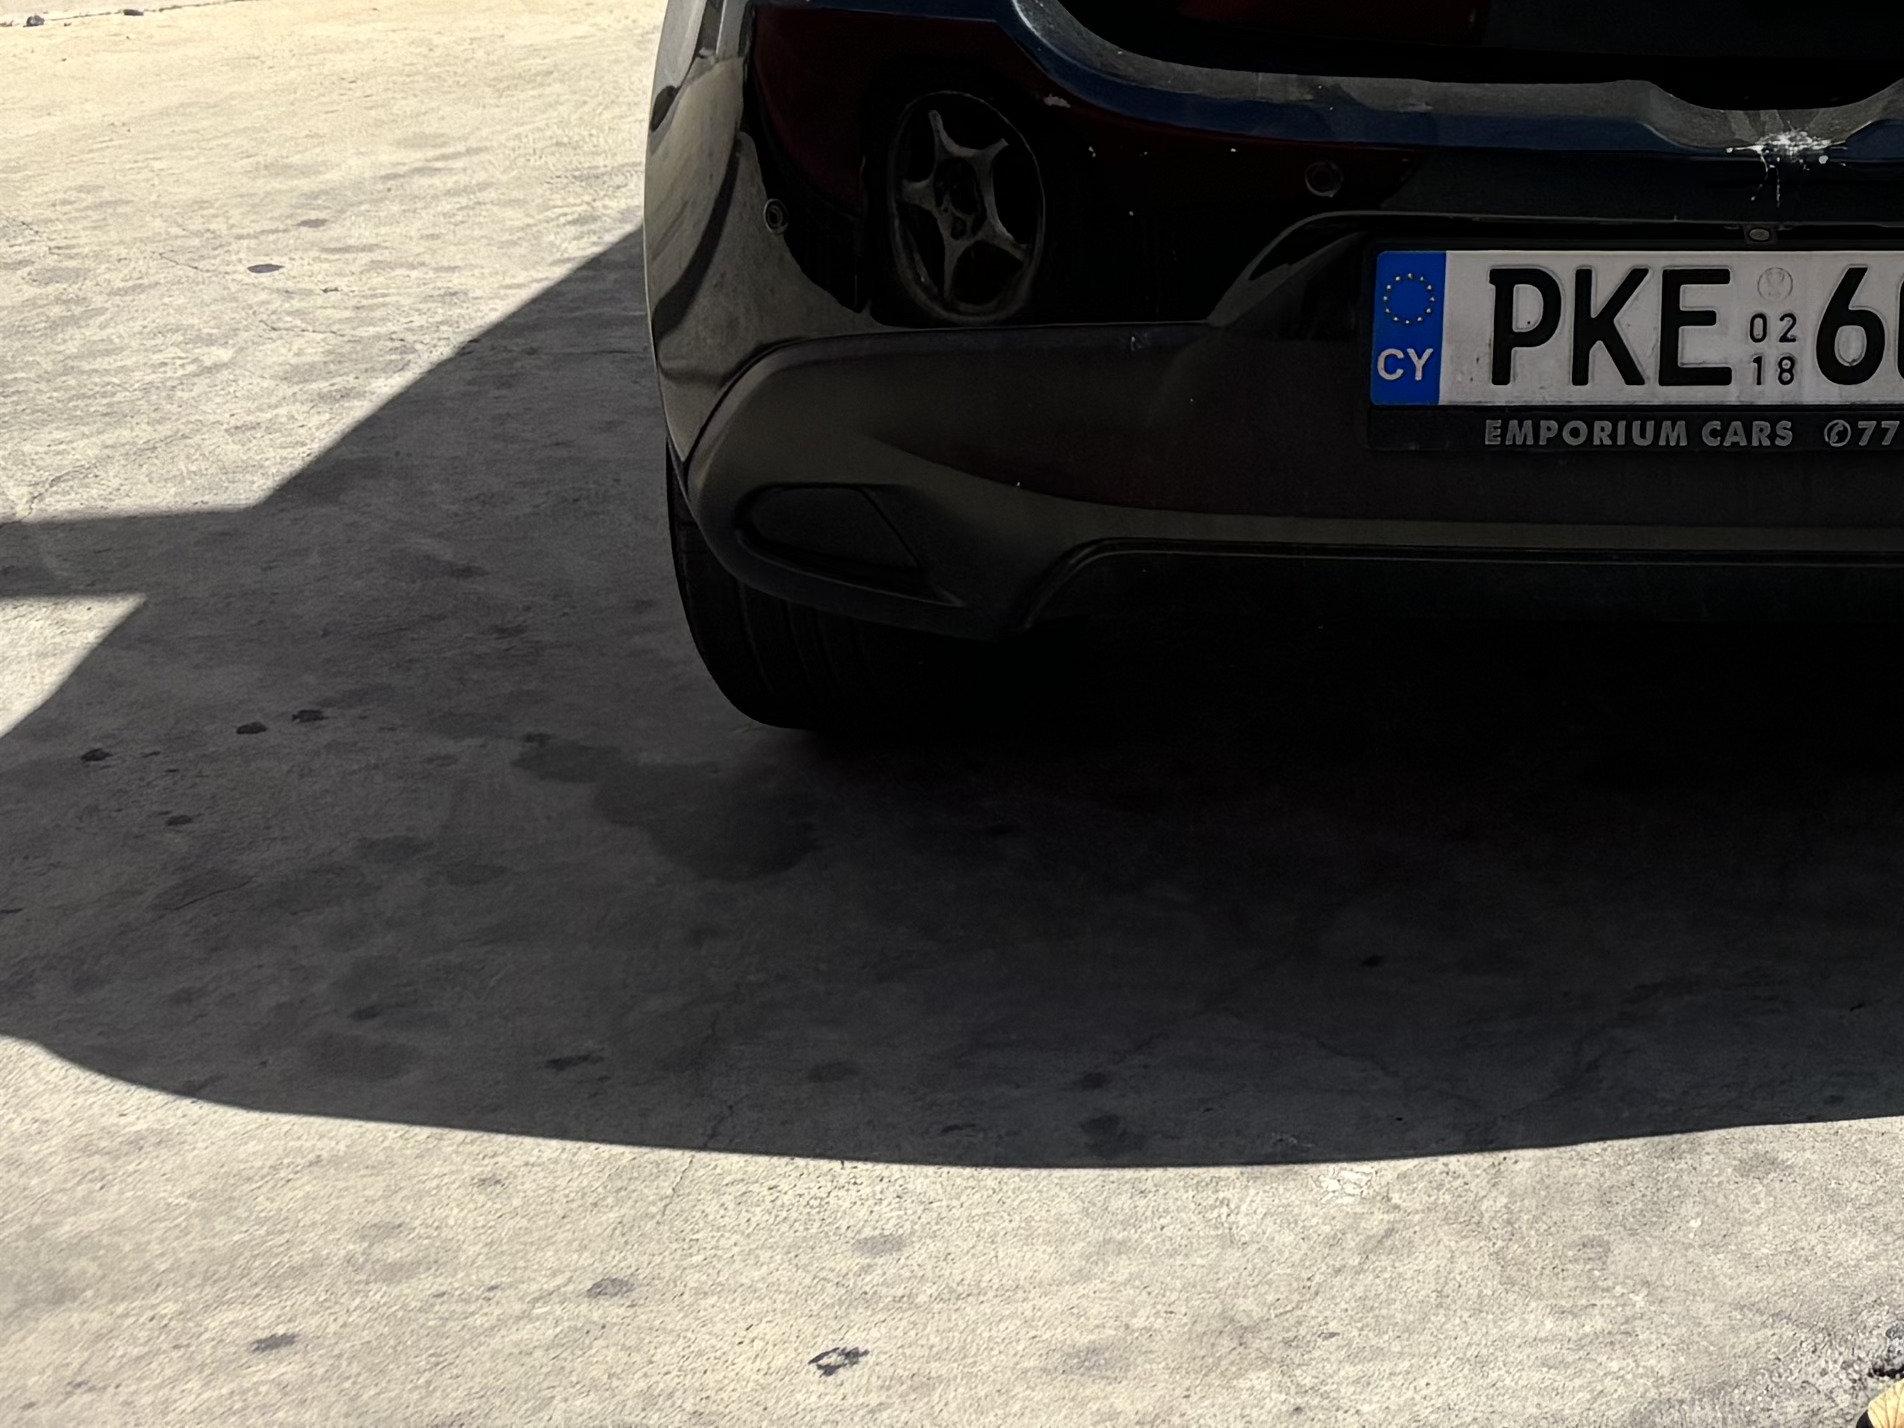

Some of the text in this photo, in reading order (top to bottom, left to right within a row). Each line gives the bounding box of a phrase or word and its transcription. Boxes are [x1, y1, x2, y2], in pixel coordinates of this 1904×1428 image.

[1489, 268, 1733, 387] PKE
[1749, 312, 1797, 343] 02
[1376, 347, 1434, 382] CY
[1752, 355, 1796, 387] 18
[1484, 419, 1688, 446] EMPORIUM
[1701, 420, 1794, 447] CARS
